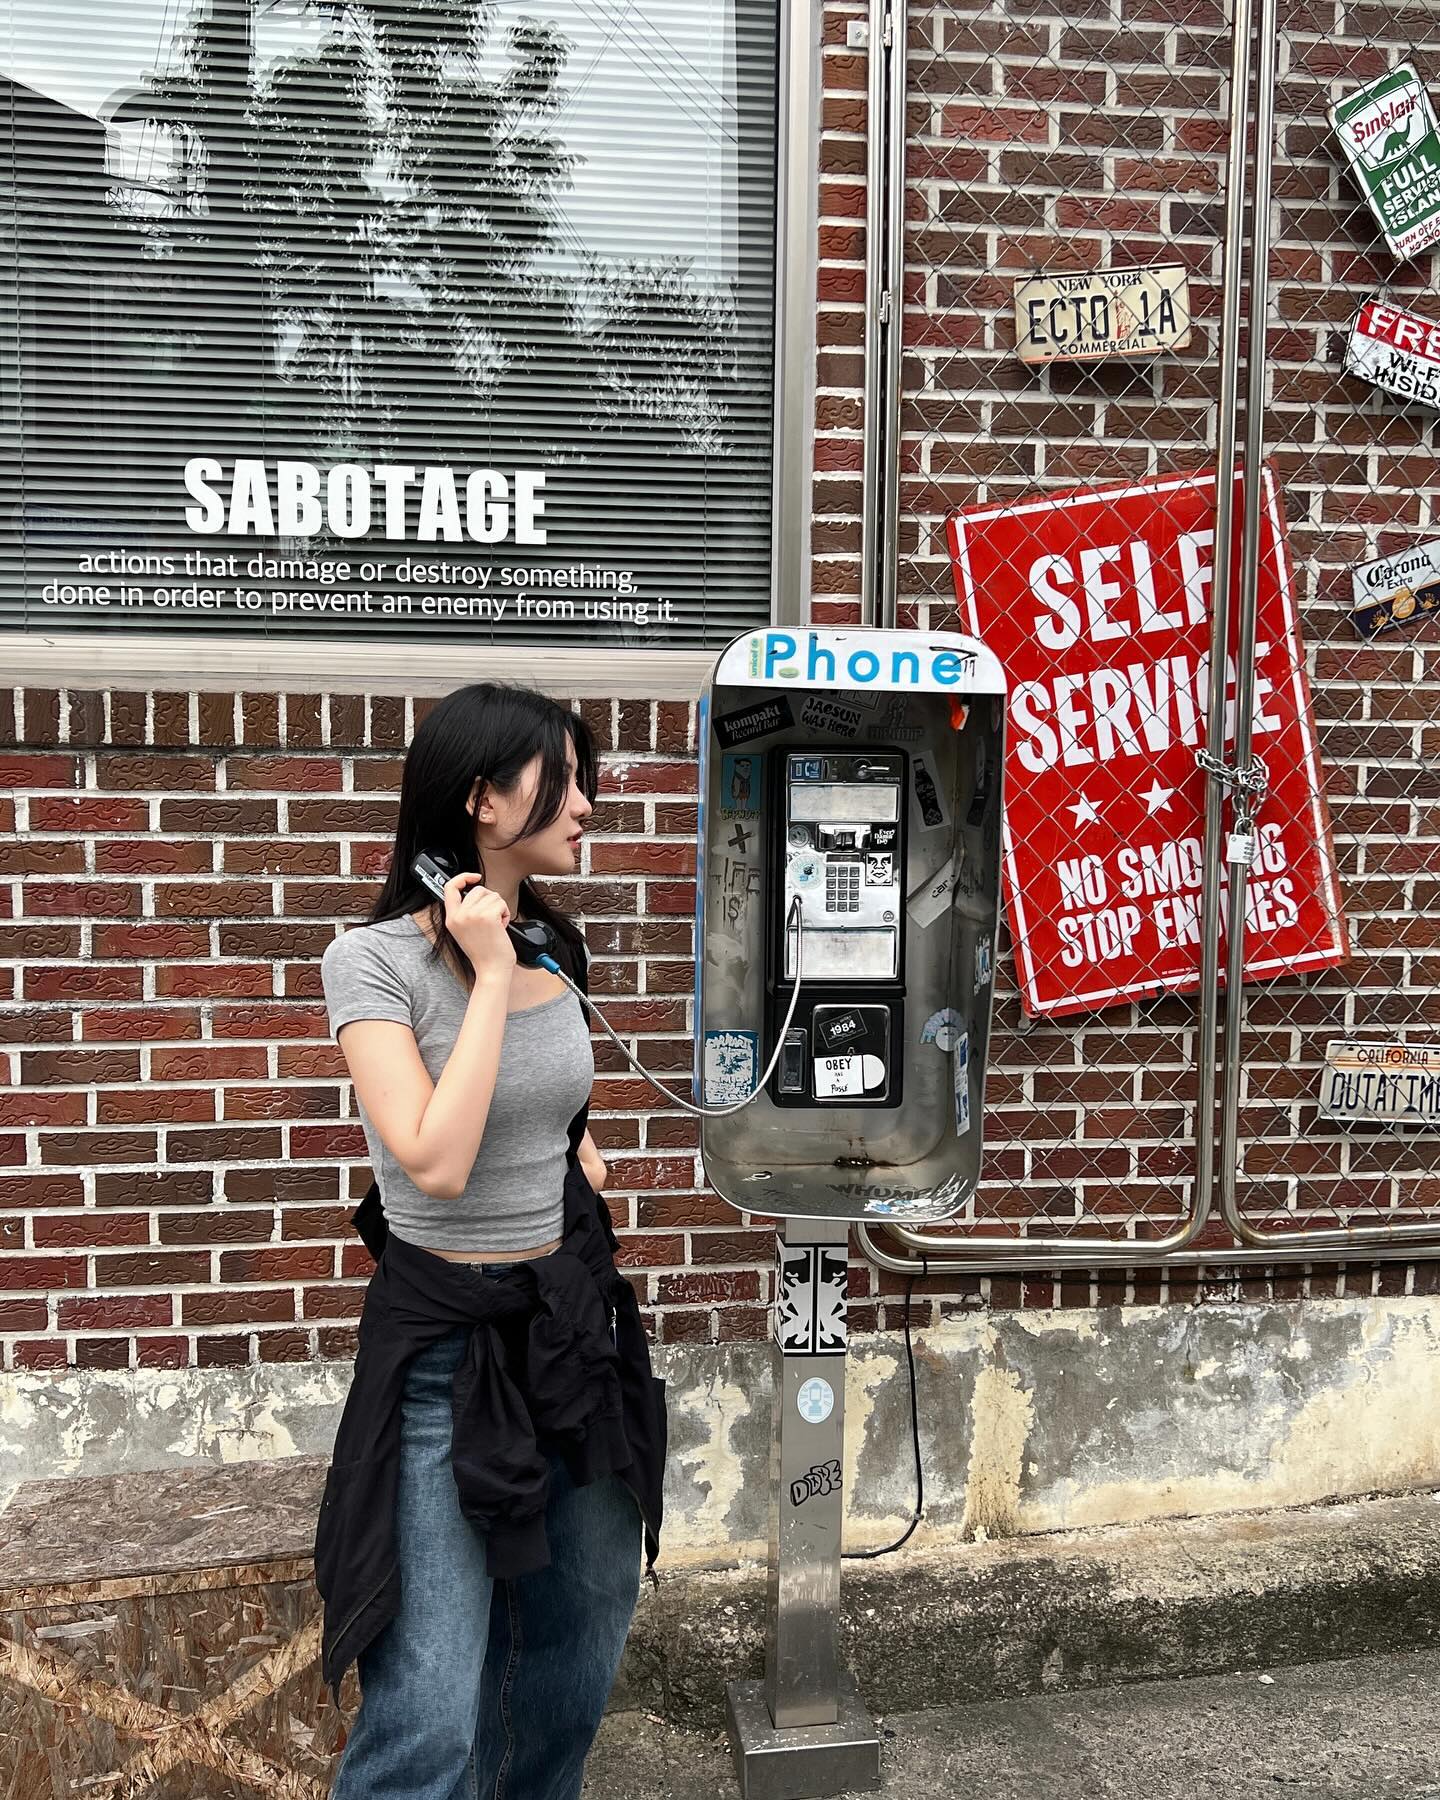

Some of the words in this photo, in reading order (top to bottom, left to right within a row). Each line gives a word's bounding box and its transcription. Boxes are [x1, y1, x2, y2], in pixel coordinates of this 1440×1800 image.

[1352, 94, 1417, 143] Sinclair
[1381, 154, 1437, 198] FULL
[1394, 232, 1417, 250] TURN
[1419, 221, 1433, 236] OFF
[1057, 277, 1092, 292] NEW
[1101, 273, 1143, 289] YORK
[1028, 294, 1109, 344] ECTO
[1138, 288, 1177, 336] 1A
[1060, 337, 1147, 355] COMMERCIAL
[183, 458, 547, 545] SABOTAGE
[78, 549, 175, 576] actions
[184, 550, 239, 578] that
[247, 552, 351, 584] damage
[360, 563, 387, 582] or
[395, 557, 493, 589] destroy
[500, 563, 639, 594] something,
[1028, 528, 1214, 650] SELF
[1366, 554, 1431, 587] Corona
[1387, 577, 1412, 590] Extra
[41, 578, 110, 606] done
[120, 581, 144, 606] in
[153, 582, 226, 609] order
[234, 586, 262, 610] to
[271, 590, 373, 614] prevent
[382, 594, 412, 614] an
[421, 595, 506, 621] enemy
[515, 592, 575, 618] from
[584, 597, 649, 625] using
[657, 598, 679, 622] it.
[765, 632, 962, 685] Phone
[724, 703, 781, 733] kompakt
[802, 711, 827, 728] WAS
[1011, 640, 1281, 773] SERVICE
[1056, 854, 1108, 911] NO
[1117, 823, 1288, 899] SMONG
[1057, 905, 1142, 969] STOP
[830, 1020, 856, 1036] 1984
[825, 1058, 852, 1070] OBEY
